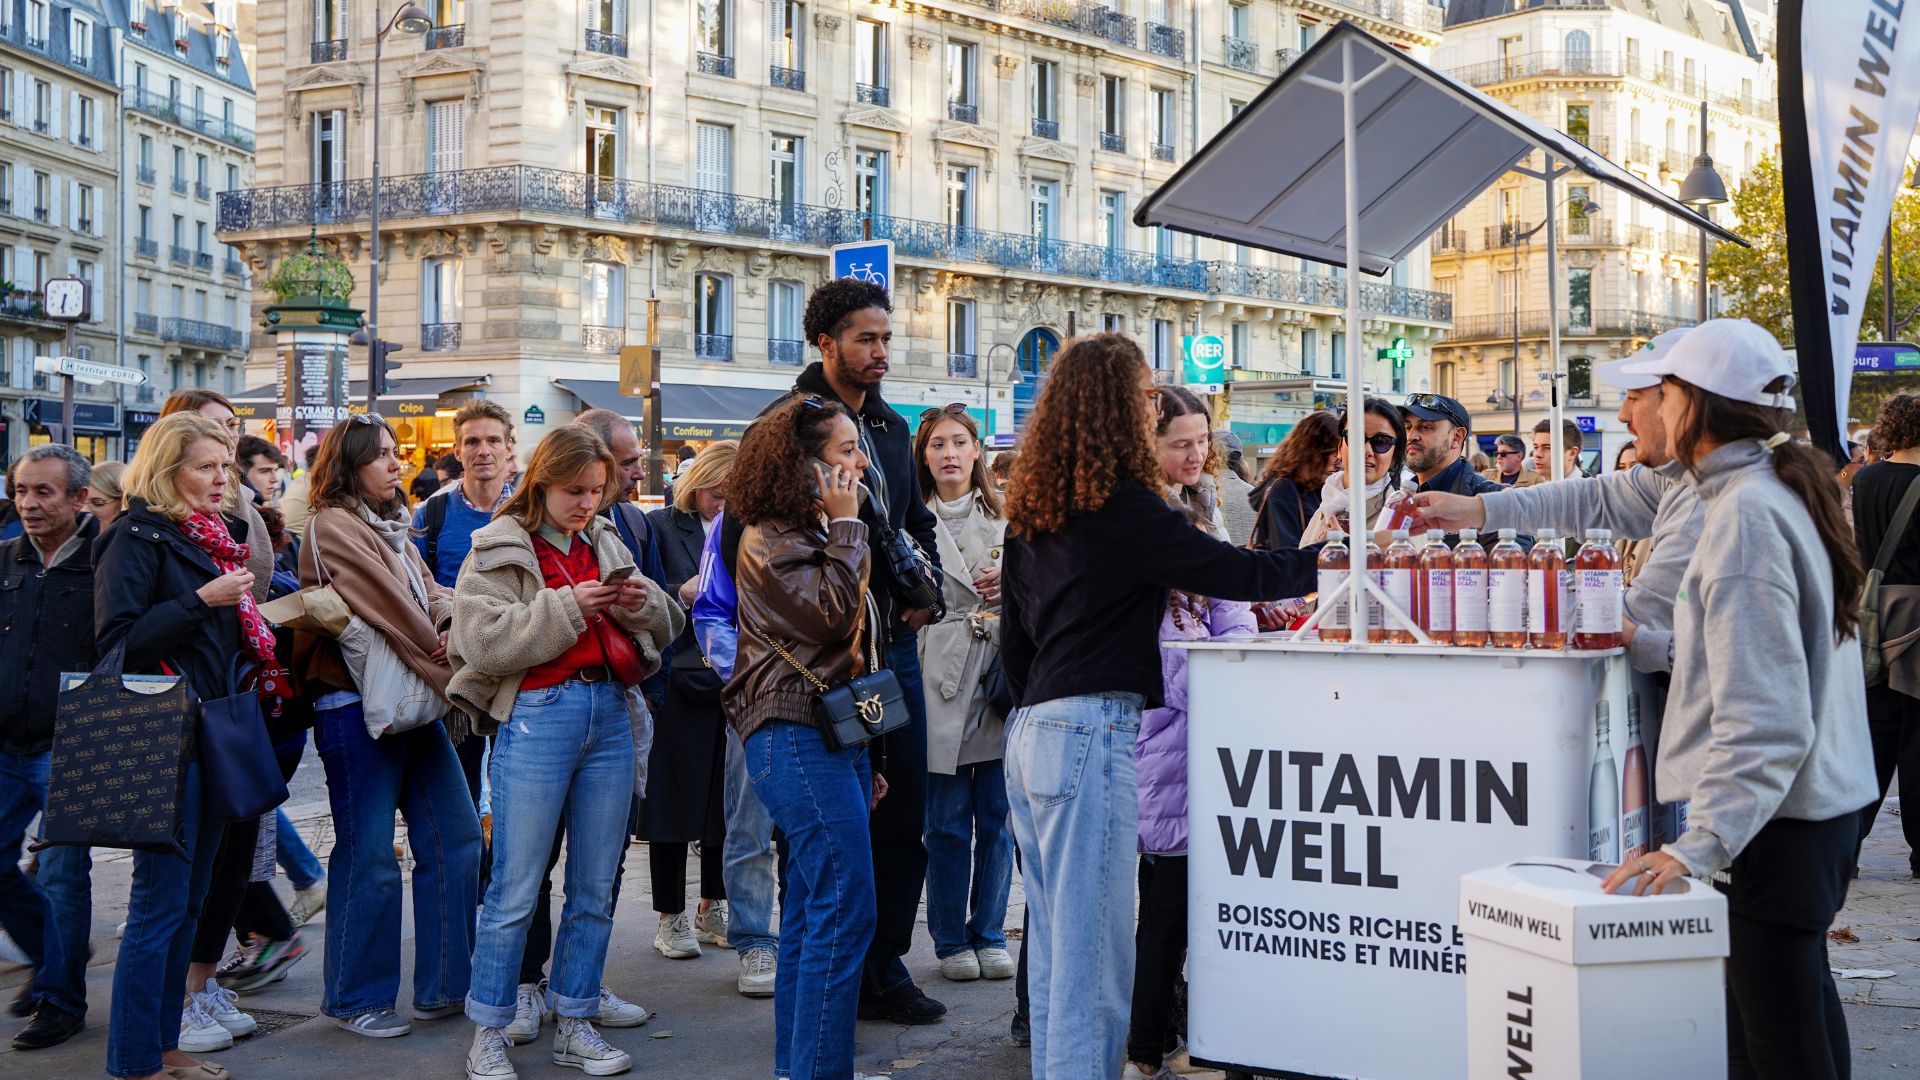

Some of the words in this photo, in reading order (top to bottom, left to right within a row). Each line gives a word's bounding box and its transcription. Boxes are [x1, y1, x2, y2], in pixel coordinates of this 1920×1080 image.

[1195, 343, 1223, 358] RER
[76, 364, 107, 376] Institut
[111, 369, 135, 380] CURIE
[295, 405, 335, 414] CYRANO
[398, 403, 424, 414] Crêpe
[673, 425, 714, 437] Confiseur
[101, 676, 119, 685] M&S
[88, 695, 109, 705] M&S
[156, 699, 177, 710] M&S
[60, 701, 81, 711] M&S
[129, 704, 150, 714] M&S
[102, 709, 122, 718] M&S
[74, 715, 95, 725] M&S
[144, 719, 165, 729] M&S
[89, 728, 110, 738] M&S
[117, 724, 137, 733] M&S
[62, 735, 82, 746] M&S
[158, 733, 178, 742] M&S
[103, 742, 124, 753] M&S
[131, 739, 151, 748] M&S
[75, 748, 96, 759] M&S
[146, 752, 166, 762] M&S
[91, 762, 111, 772] M&S
[118, 758, 138, 767] M&S
[63, 769, 83, 779] M&S
[160, 767, 178, 776] M&S
[104, 777, 124, 786] M&S
[132, 772, 152, 782] M&S
[77, 782, 97, 793] M&S
[147, 786, 167, 797] M&S
[1217, 747, 1528, 826] VITAMIN
[50, 789, 69, 798] M&S
[119, 792, 140, 801] M&S
[92, 796, 112, 806] M&S
[64, 803, 85, 813] M&S
[133, 806, 153, 815] M&S
[78, 816, 98, 826] M&S
[106, 811, 126, 821] M&S
[148, 821, 168, 830] M&S
[1217, 815, 1398, 889] WELL
[1218, 903, 1341, 934] BOISSONS
[1350, 915, 1442, 944] RICHES
[1468, 900, 1524, 930] VITAMIN
[1527, 916, 1562, 941] WELL
[1589, 920, 1664, 940] VITAMIN
[1670, 917, 1713, 935] WELL
[1218, 929, 1347, 962] VITAMINES
[1356, 944, 1380, 965] ET
[1507, 985, 1533, 1080] WELL
